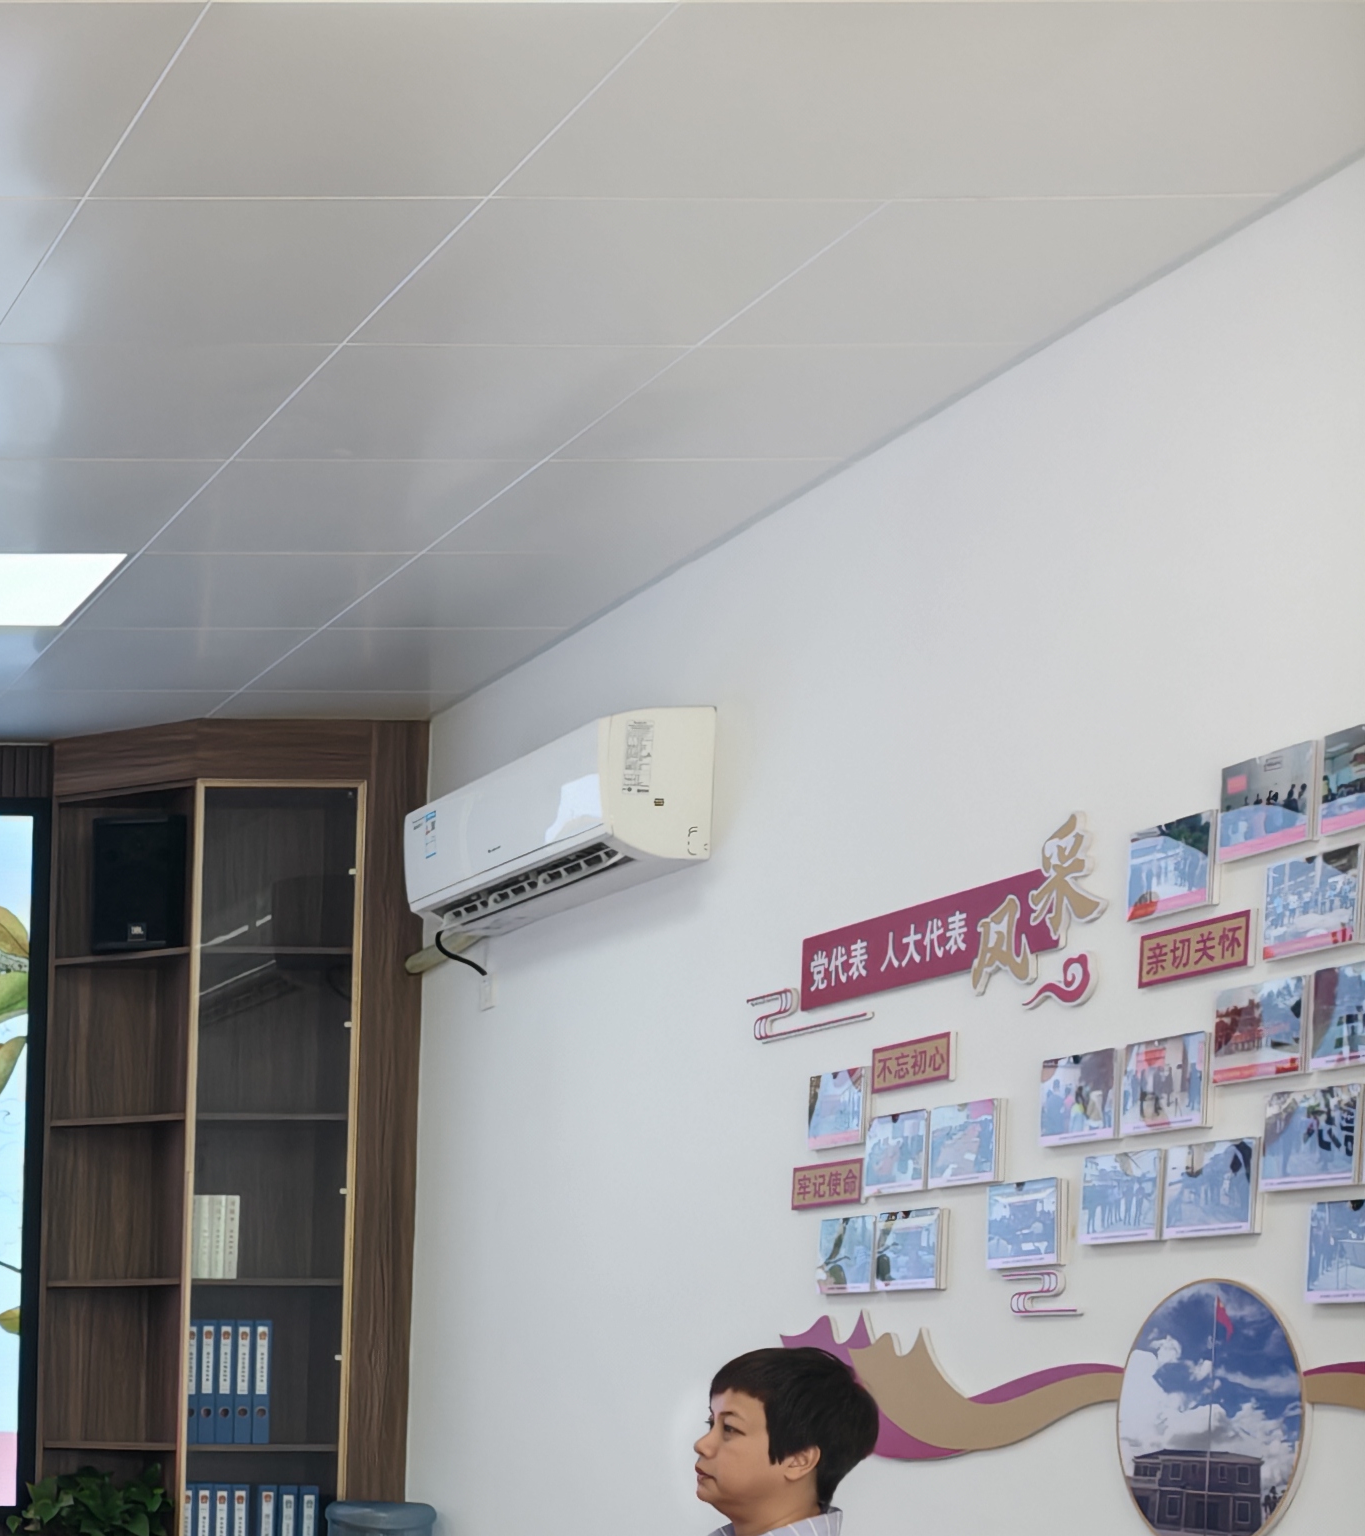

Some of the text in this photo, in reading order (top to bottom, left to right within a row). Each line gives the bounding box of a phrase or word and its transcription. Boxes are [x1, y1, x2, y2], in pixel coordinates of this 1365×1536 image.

[810, 811, 1109, 997] 党代表 人大代表 风采
[1146, 925, 1243, 976] 亲切关怀
[876, 1046, 945, 1083] 不忘初心
[796, 1168, 857, 1200] 牢记使命
